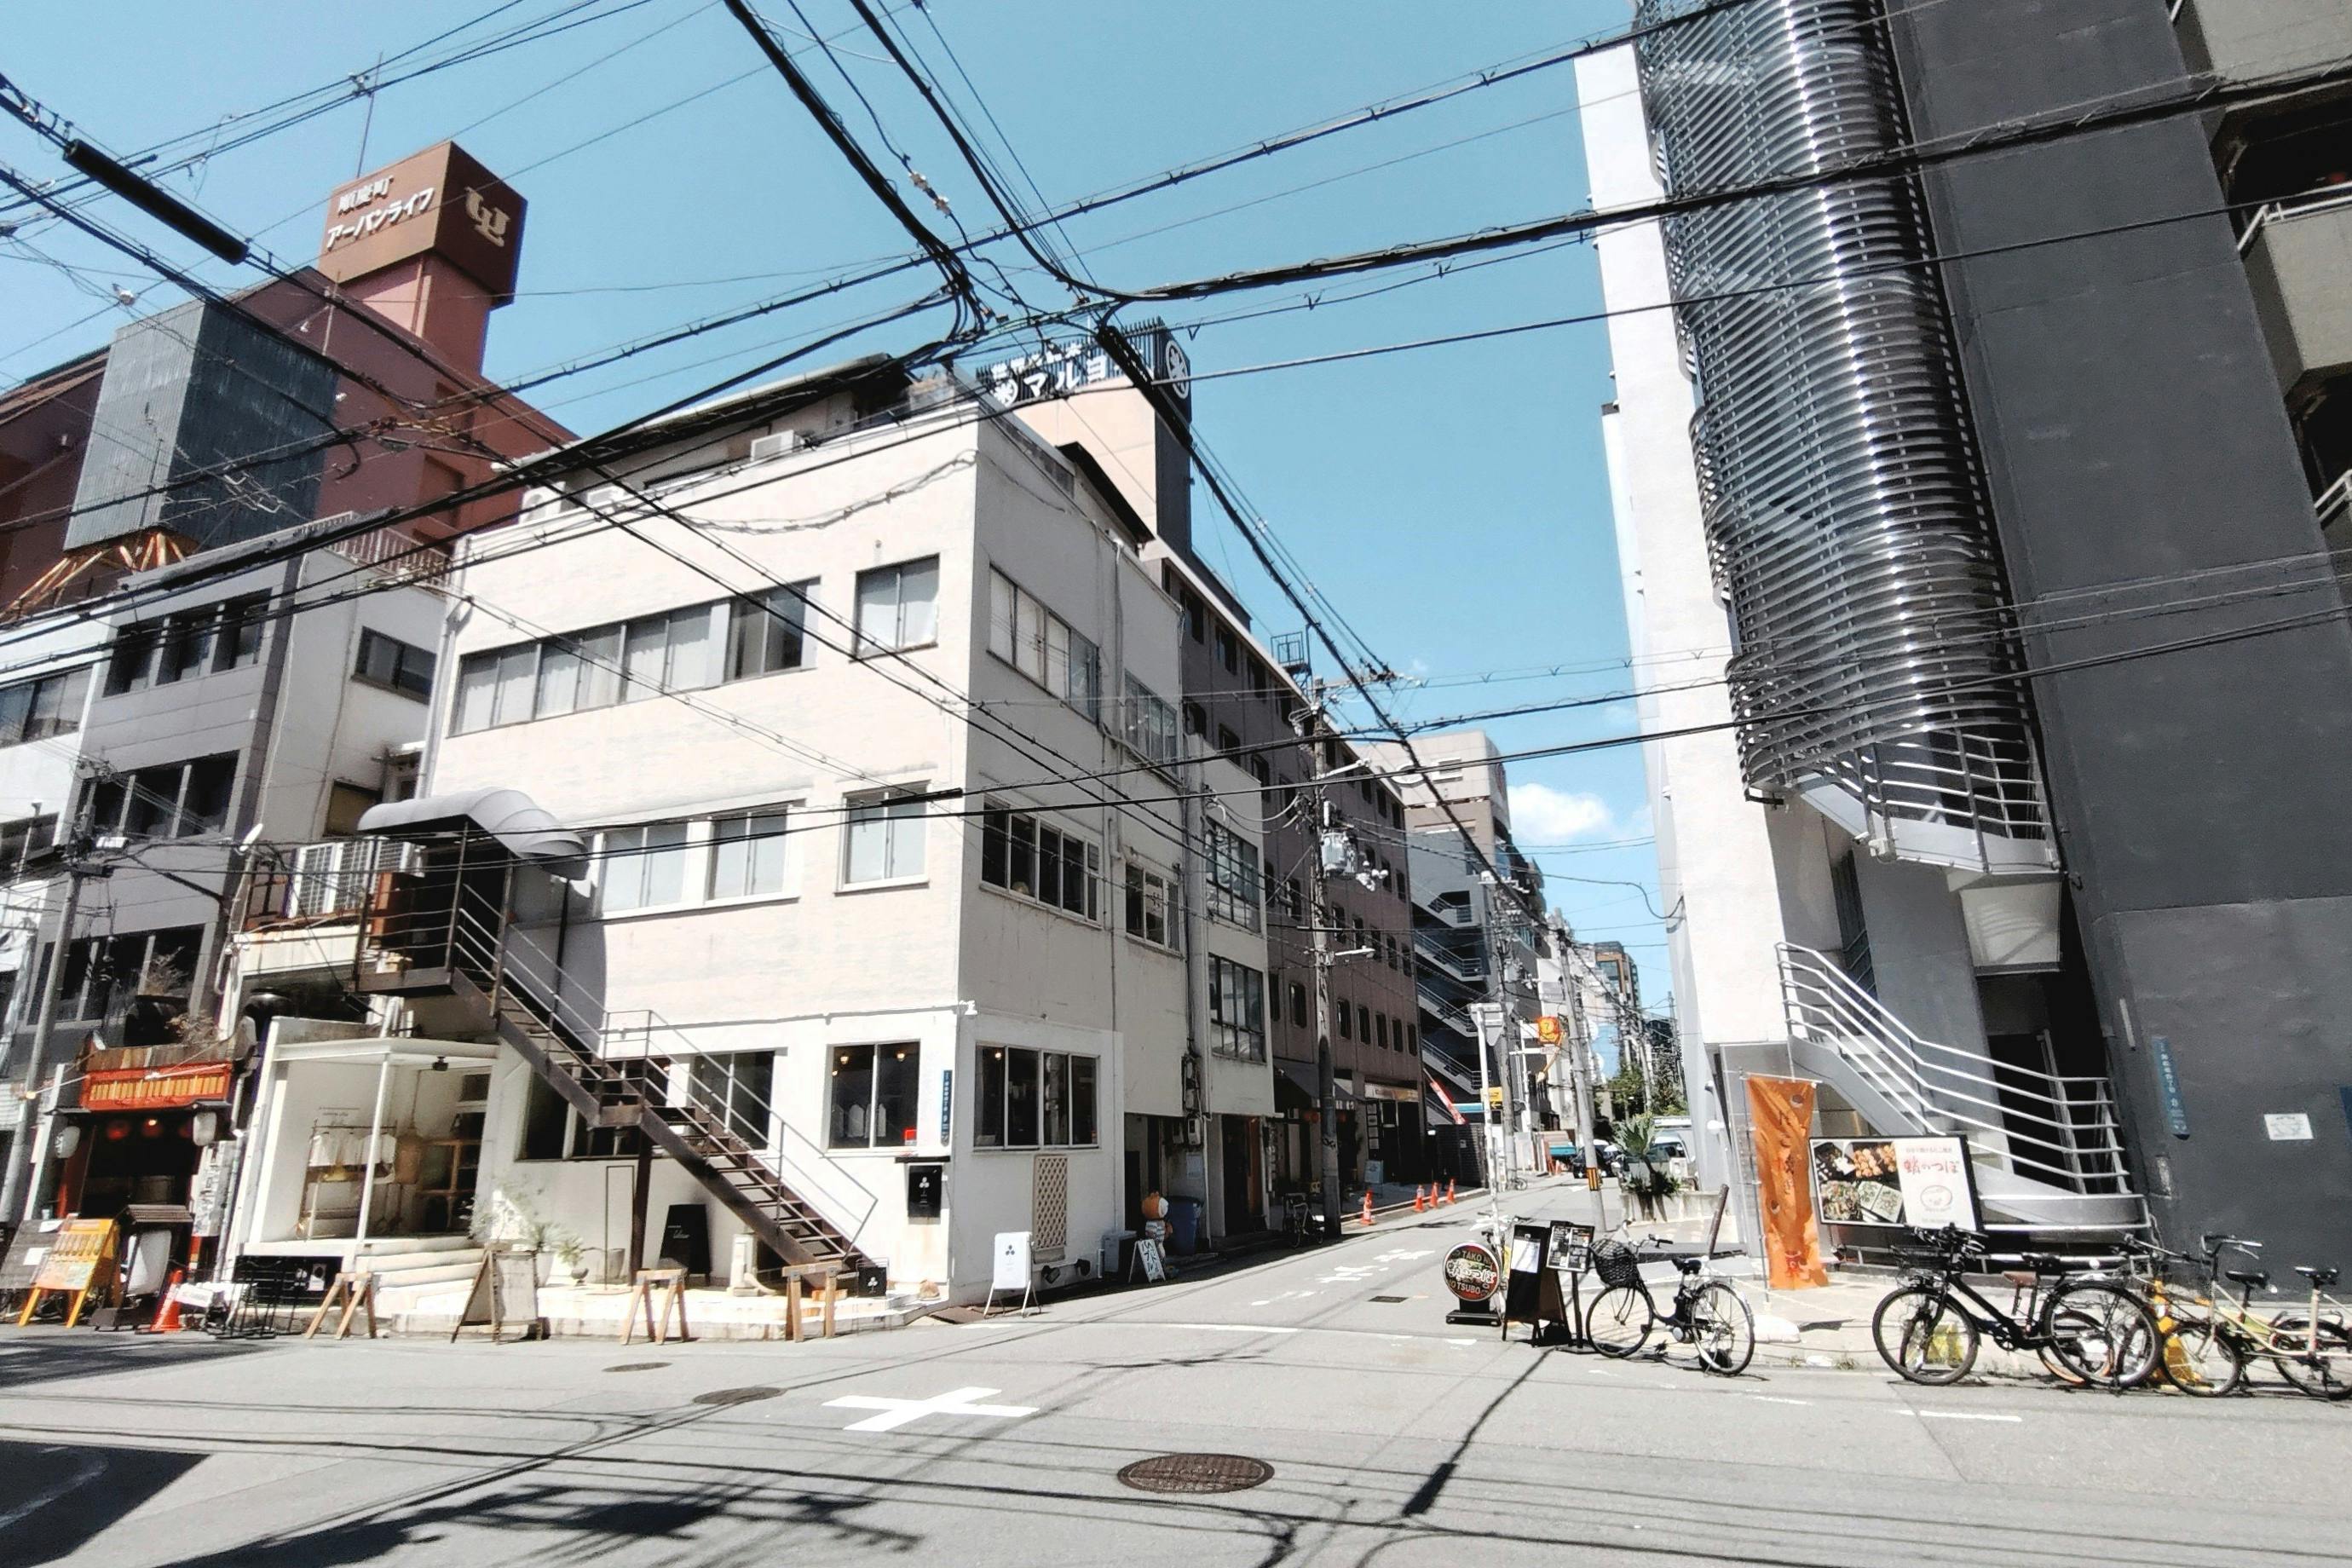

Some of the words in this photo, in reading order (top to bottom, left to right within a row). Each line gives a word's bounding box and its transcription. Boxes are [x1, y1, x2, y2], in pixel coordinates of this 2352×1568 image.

[326, 187, 435, 251] アーバンライフ
[1461, 1250, 1483, 1262] TAKO
